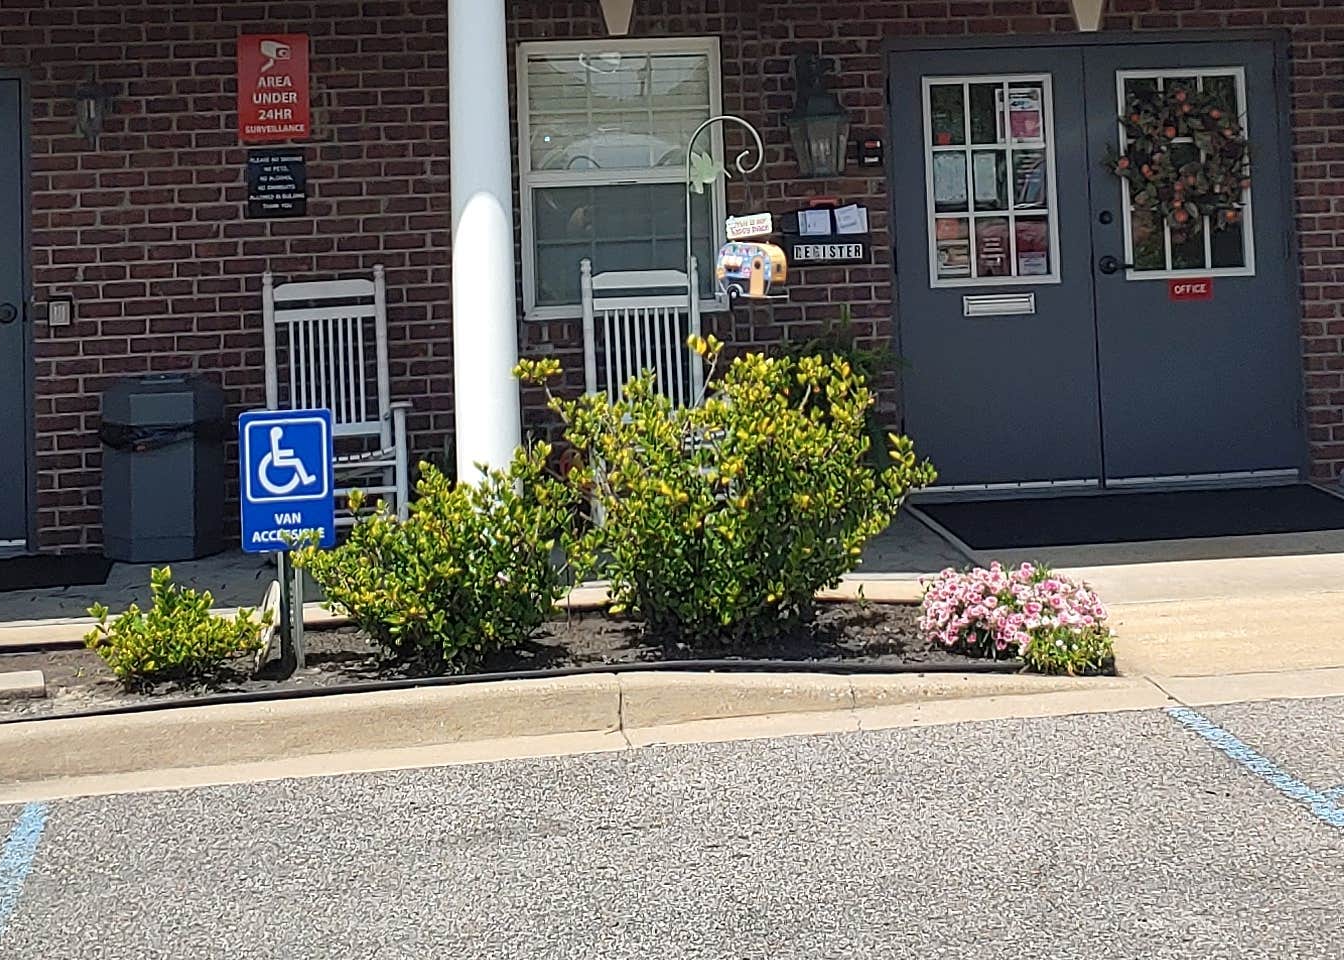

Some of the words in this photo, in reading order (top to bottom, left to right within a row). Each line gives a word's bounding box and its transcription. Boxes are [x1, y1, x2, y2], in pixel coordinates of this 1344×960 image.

[258, 76, 292, 87] AREA
[252, 91, 297, 104] UNDER
[258, 108, 292, 120] 24HR
[245, 124, 304, 134] SURVEILLANCE
[1174, 284, 1206, 294] OFFICE
[274, 512, 301, 525] VAN
[252, 527, 325, 543] ACCESIE
